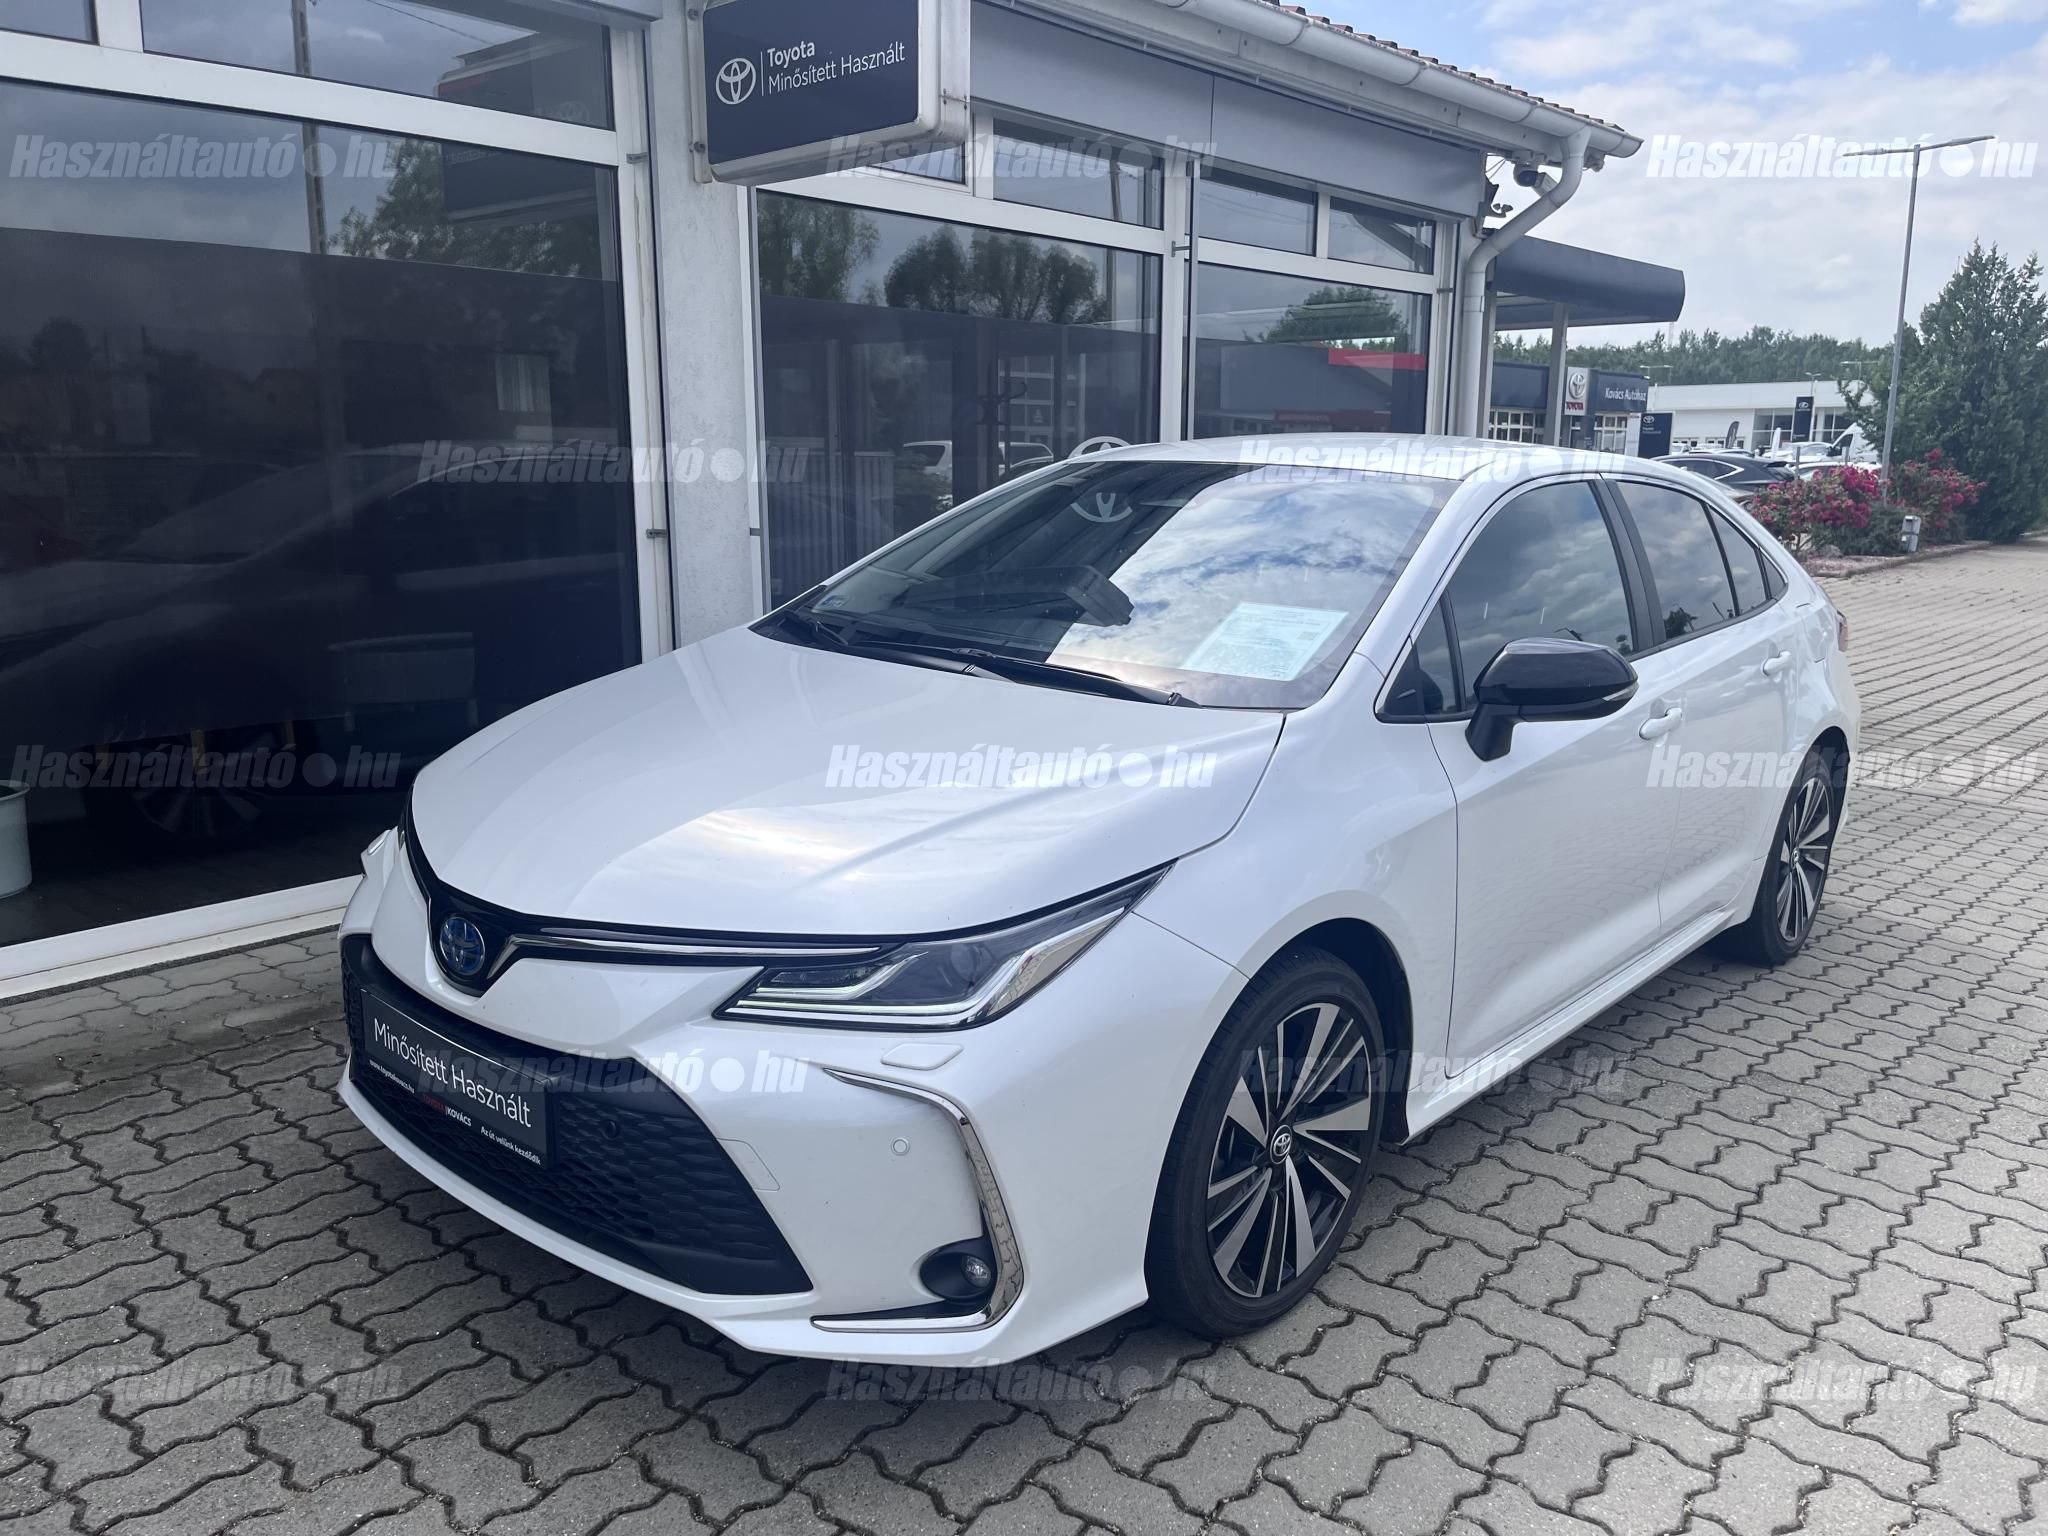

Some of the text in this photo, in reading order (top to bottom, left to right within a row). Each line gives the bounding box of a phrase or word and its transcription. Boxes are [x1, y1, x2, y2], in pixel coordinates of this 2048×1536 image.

[767, 41, 816, 69] Toyota
[768, 41, 906, 94] Minősített Használt
[374, 1017, 532, 1128] Minősített Használt
[446, 1106, 472, 1127] KOVÁCS
